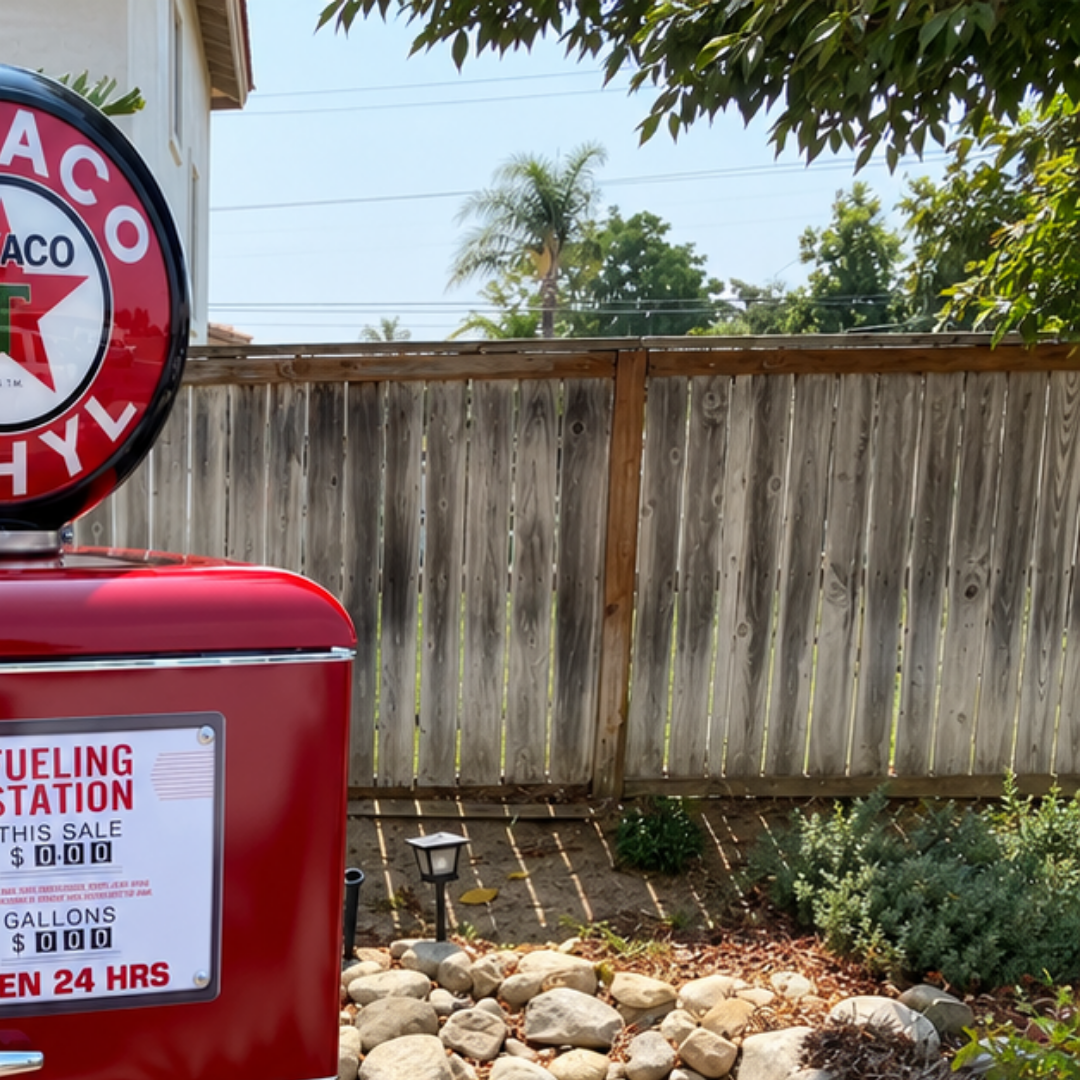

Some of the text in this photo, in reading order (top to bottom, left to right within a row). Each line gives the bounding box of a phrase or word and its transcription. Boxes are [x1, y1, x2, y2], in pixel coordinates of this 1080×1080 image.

[62, 820, 123, 839] SALE
[3, 906, 116, 930] GALLONS
[53, 967, 95, 995] 24
[106, 962, 171, 991] HRS
